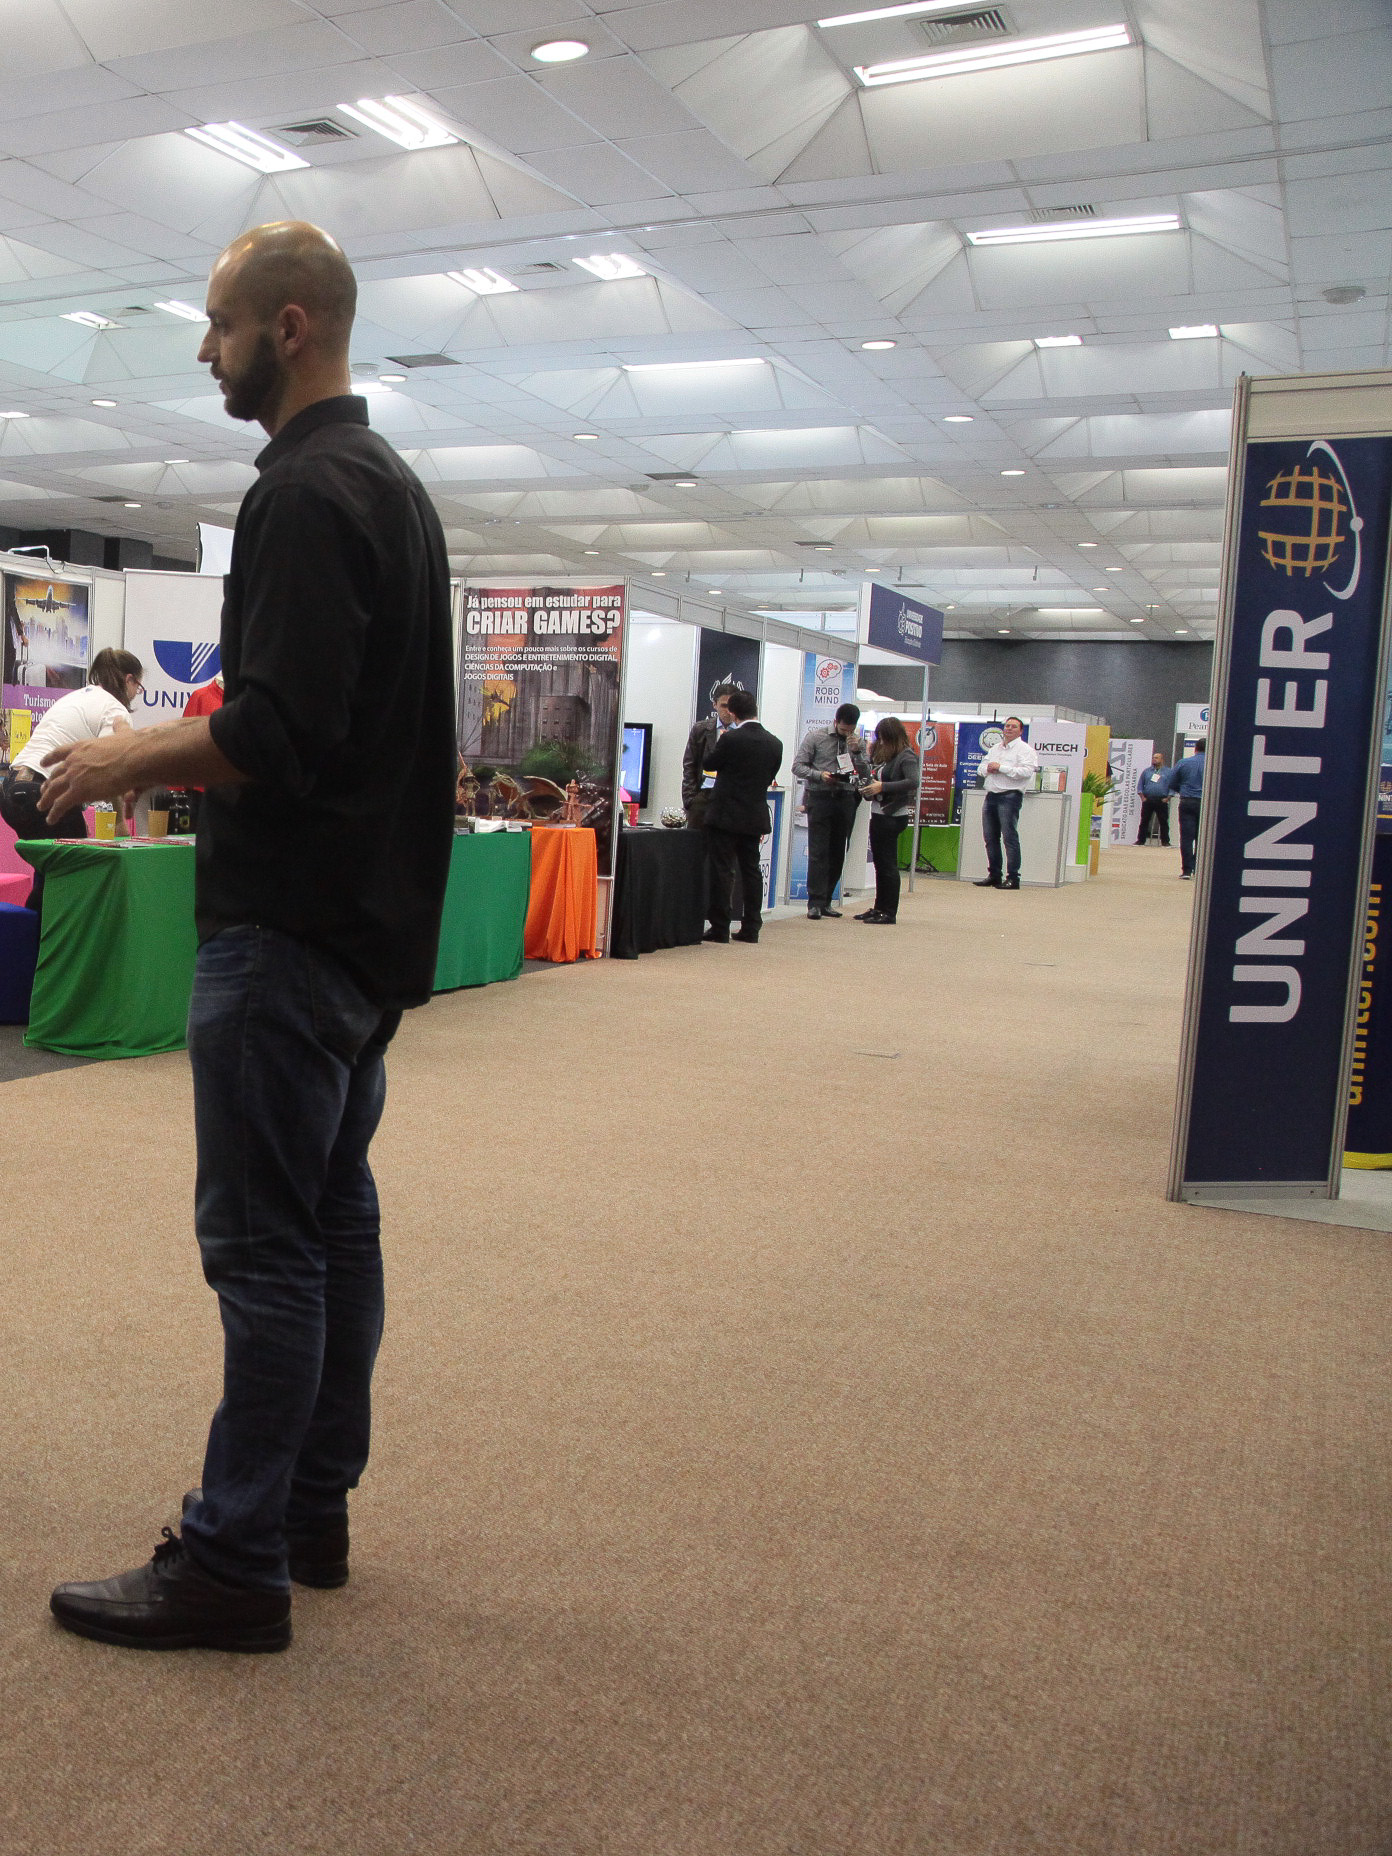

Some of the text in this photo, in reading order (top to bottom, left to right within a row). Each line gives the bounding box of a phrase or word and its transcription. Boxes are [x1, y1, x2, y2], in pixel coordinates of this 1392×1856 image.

[467, 593, 621, 609] Já pensou em estudar para
[466, 610, 621, 635] CRIAR GAMES?
[465, 653, 490, 661] DESIGN
[464, 662, 494, 671] CIÊNCIAS
[504, 663, 552, 672] COMPUTAÇÃO
[815, 687, 840, 695] ROBO
[23, 693, 57, 708] Turismo
[814, 695, 839, 704] MIND
[1188, 722, 1207, 730] Pear
[1034, 743, 1078, 752] UKTECH
[1228, 609, 1334, 1023] UNINTER
